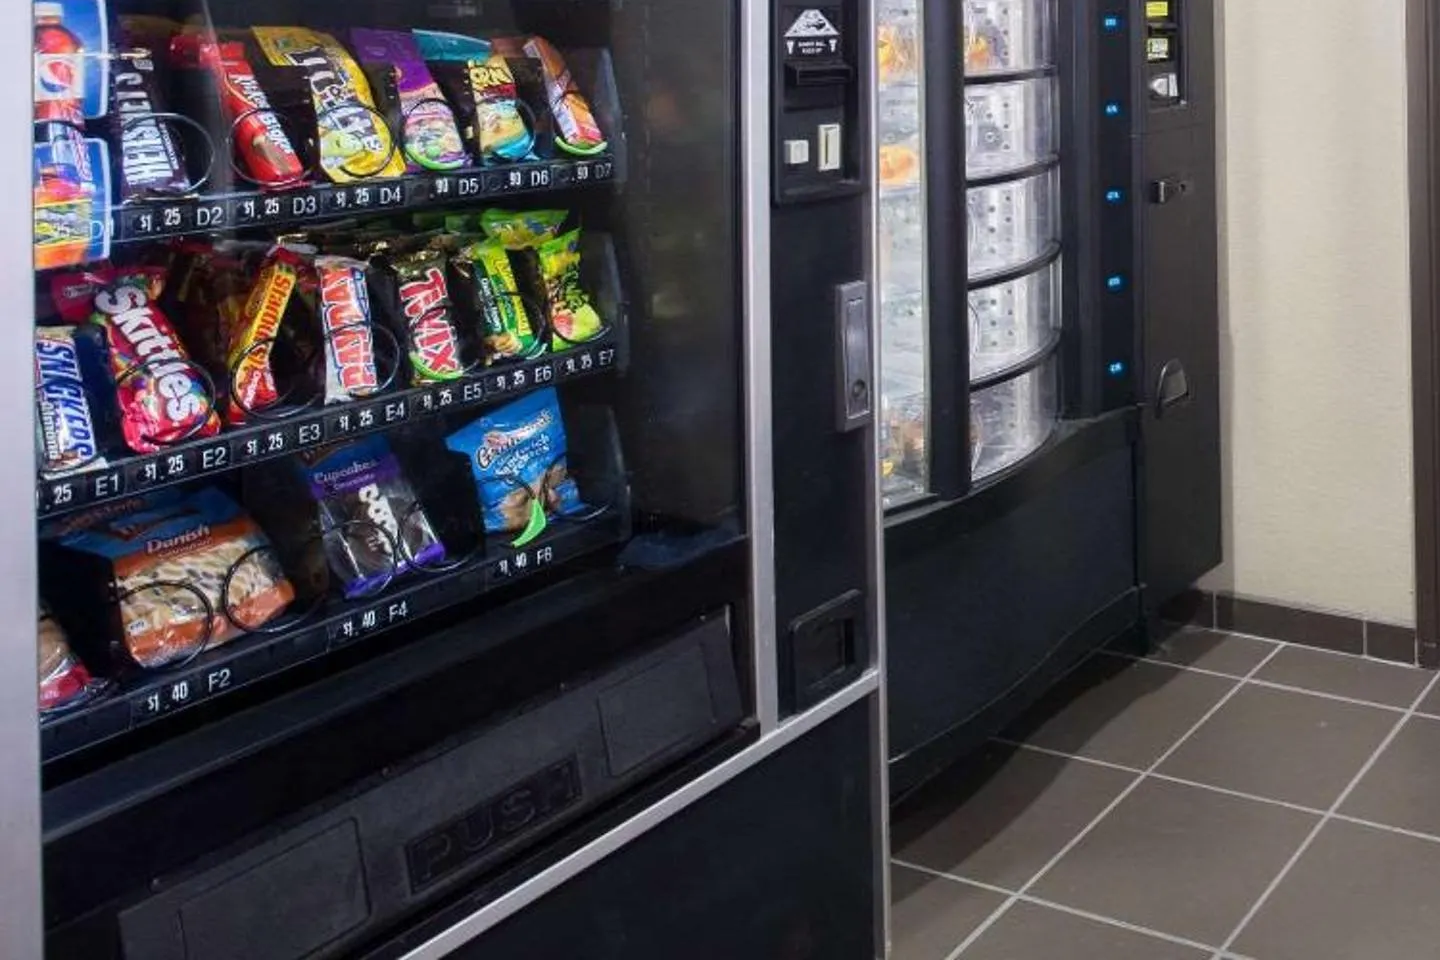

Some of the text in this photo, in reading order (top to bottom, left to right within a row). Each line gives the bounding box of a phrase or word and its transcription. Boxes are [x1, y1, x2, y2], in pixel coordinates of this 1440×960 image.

[459, 178, 480, 195] D5
[531, 170, 549, 187] D6
[293, 196, 317, 215] D3
[380, 188, 401, 205] D4
[197, 207, 223, 225] D2
[600, 349, 615, 365] E7
[535, 366, 552, 382] E6
[464, 382, 482, 400] E5
[386, 403, 405, 422] E4
[299, 423, 322, 443] E3
[202, 447, 226, 469] E2
[95, 473, 119, 496] E1
[146, 524, 212, 554] Danish
[536, 550, 553, 566] F6
[388, 600, 409, 621] F4
[207, 668, 232, 693] F2
